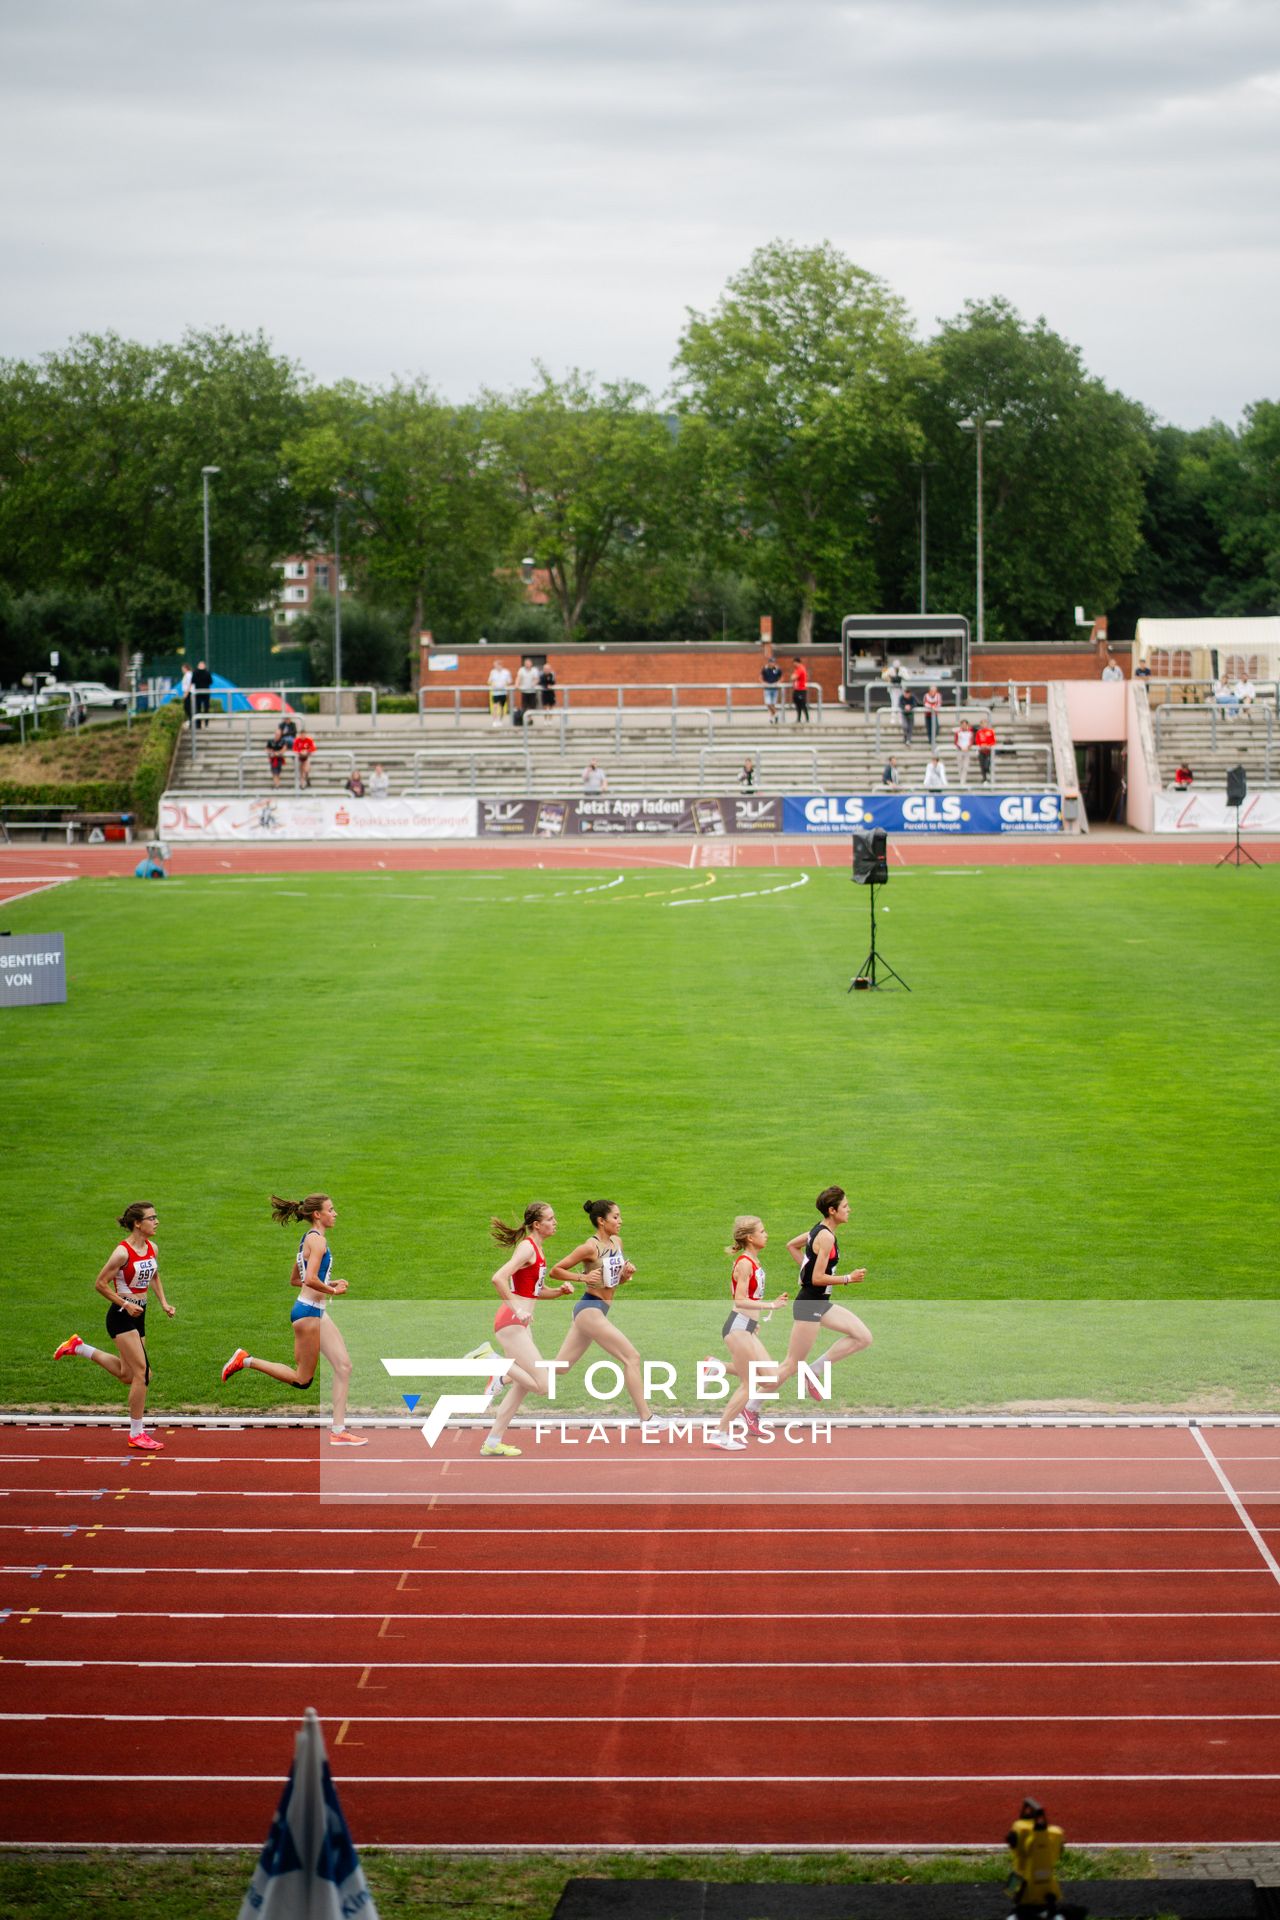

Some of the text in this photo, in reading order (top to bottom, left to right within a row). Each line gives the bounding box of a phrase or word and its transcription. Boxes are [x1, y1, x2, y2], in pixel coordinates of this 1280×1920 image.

[484, 803, 524, 819] DLV
[575, 798, 686, 817] Jetzt App laden!
[736, 801, 776, 818] DLV
[162, 804, 230, 828] DLV
[352, 814, 409, 829] Sparkasse
[4, 973, 33, 987] VON
[139, 1261, 153, 1269] GLS
[137, 1268, 154, 1280] 597
